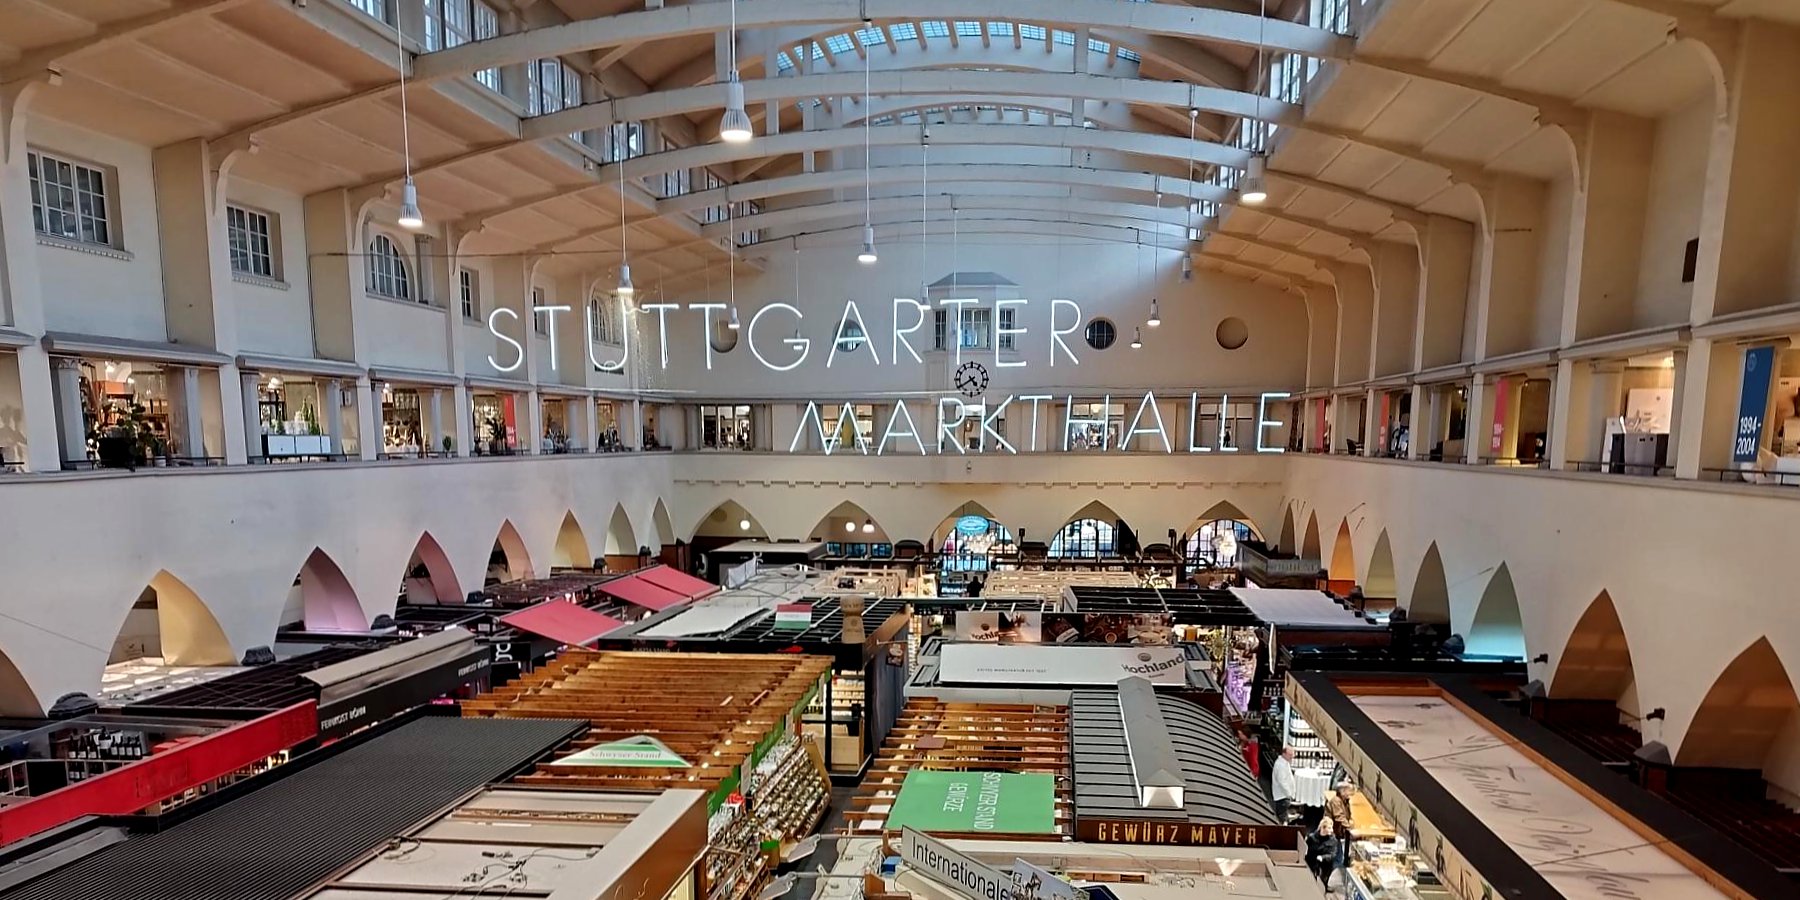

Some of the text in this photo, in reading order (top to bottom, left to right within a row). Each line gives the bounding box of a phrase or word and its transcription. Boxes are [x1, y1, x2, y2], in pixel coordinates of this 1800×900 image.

[487, 295, 1083, 373] STUTTGARTER
[790, 392, 1291, 456] MARKTHALLE
[1739, 415, 1762, 435] 1994-
[1736, 436, 1756, 455] 2004
[1120, 653, 1185, 674] Hochland
[943, 782, 969, 813] GEWÜRZE
[1097, 821, 1258, 846] GEWÜRZ MAYER
[911, 836, 1010, 900] Internationale
